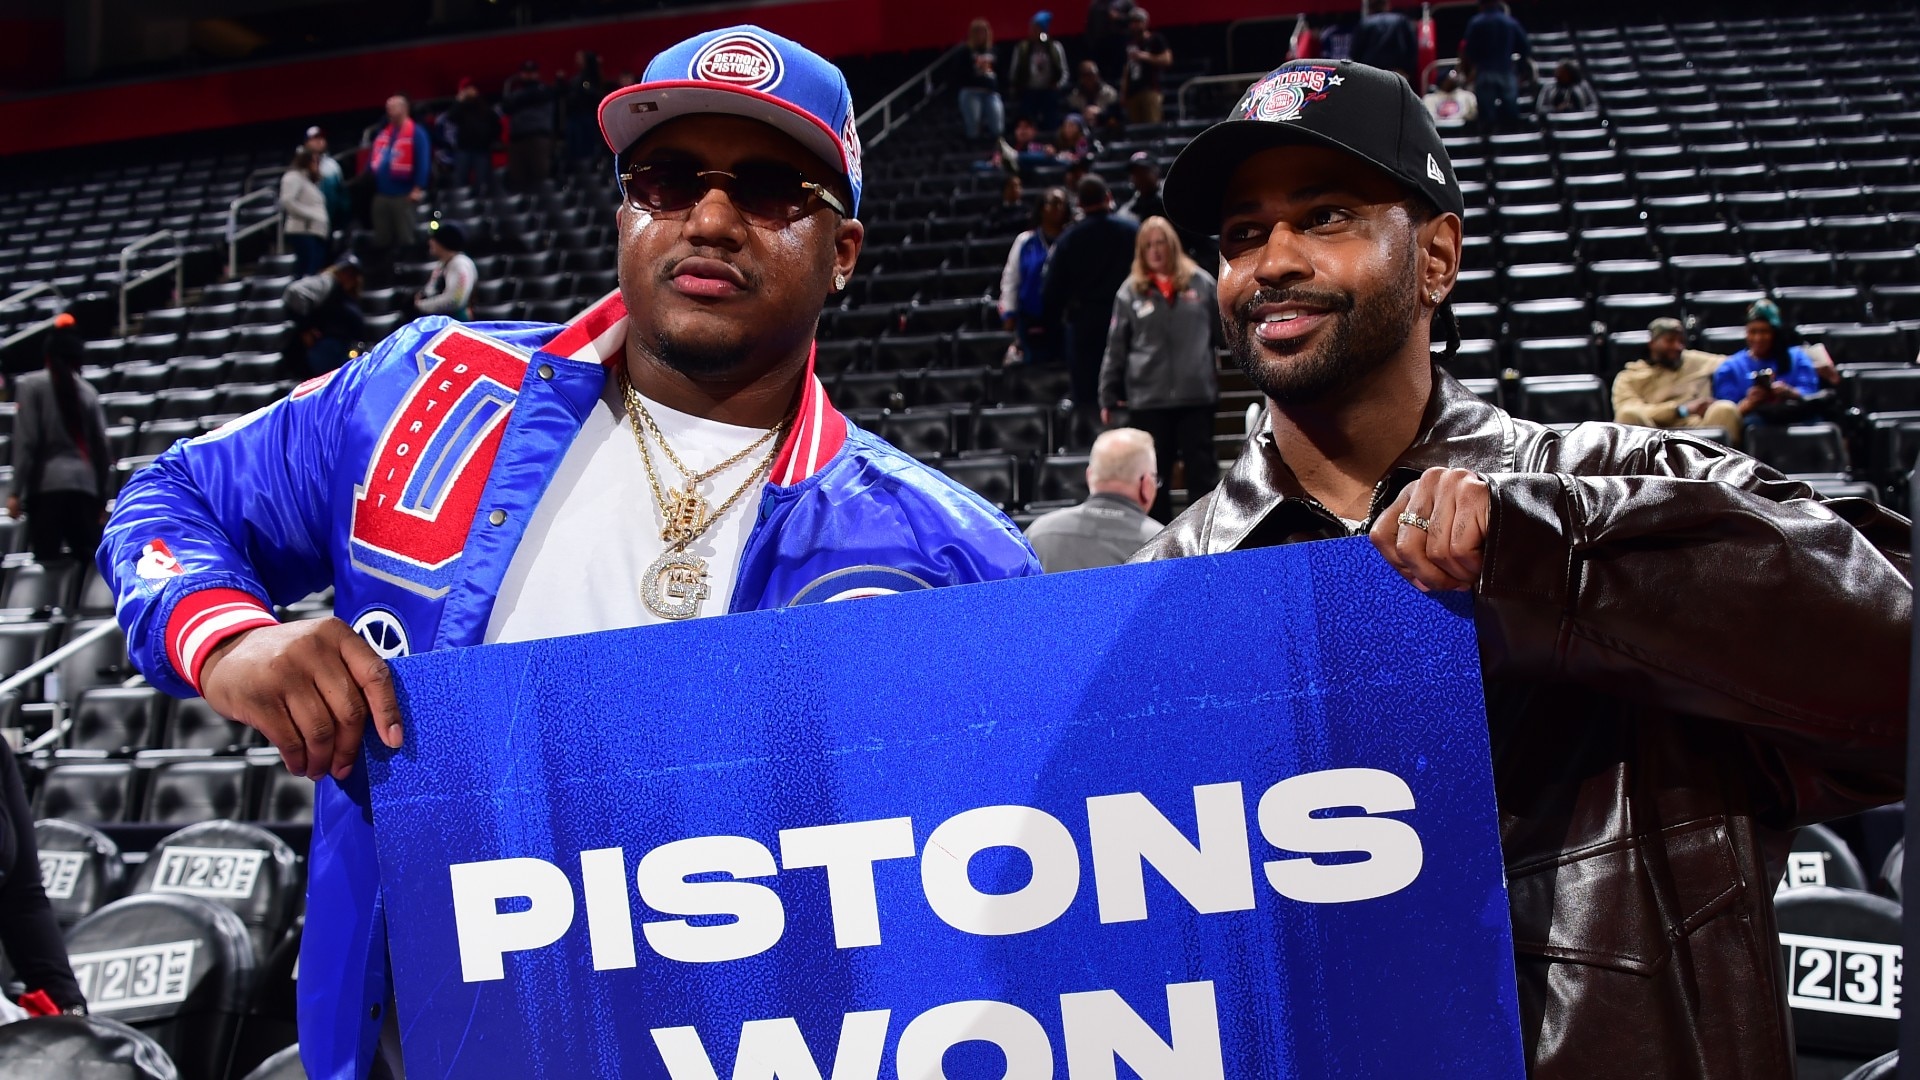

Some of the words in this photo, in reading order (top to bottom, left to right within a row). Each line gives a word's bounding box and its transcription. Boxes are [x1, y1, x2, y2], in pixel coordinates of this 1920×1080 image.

[711, 62, 760, 77] PISTONS
[713, 53, 762, 67] DETROIT
[377, 363, 468, 508] DETROIT
[167, 856, 236, 889] 123
[450, 768, 1423, 983] PISTONS
[1798, 860, 1817, 883] ET
[166, 950, 186, 995] NET
[1797, 948, 1879, 1004] 23
[650, 980, 1225, 1080] WON
